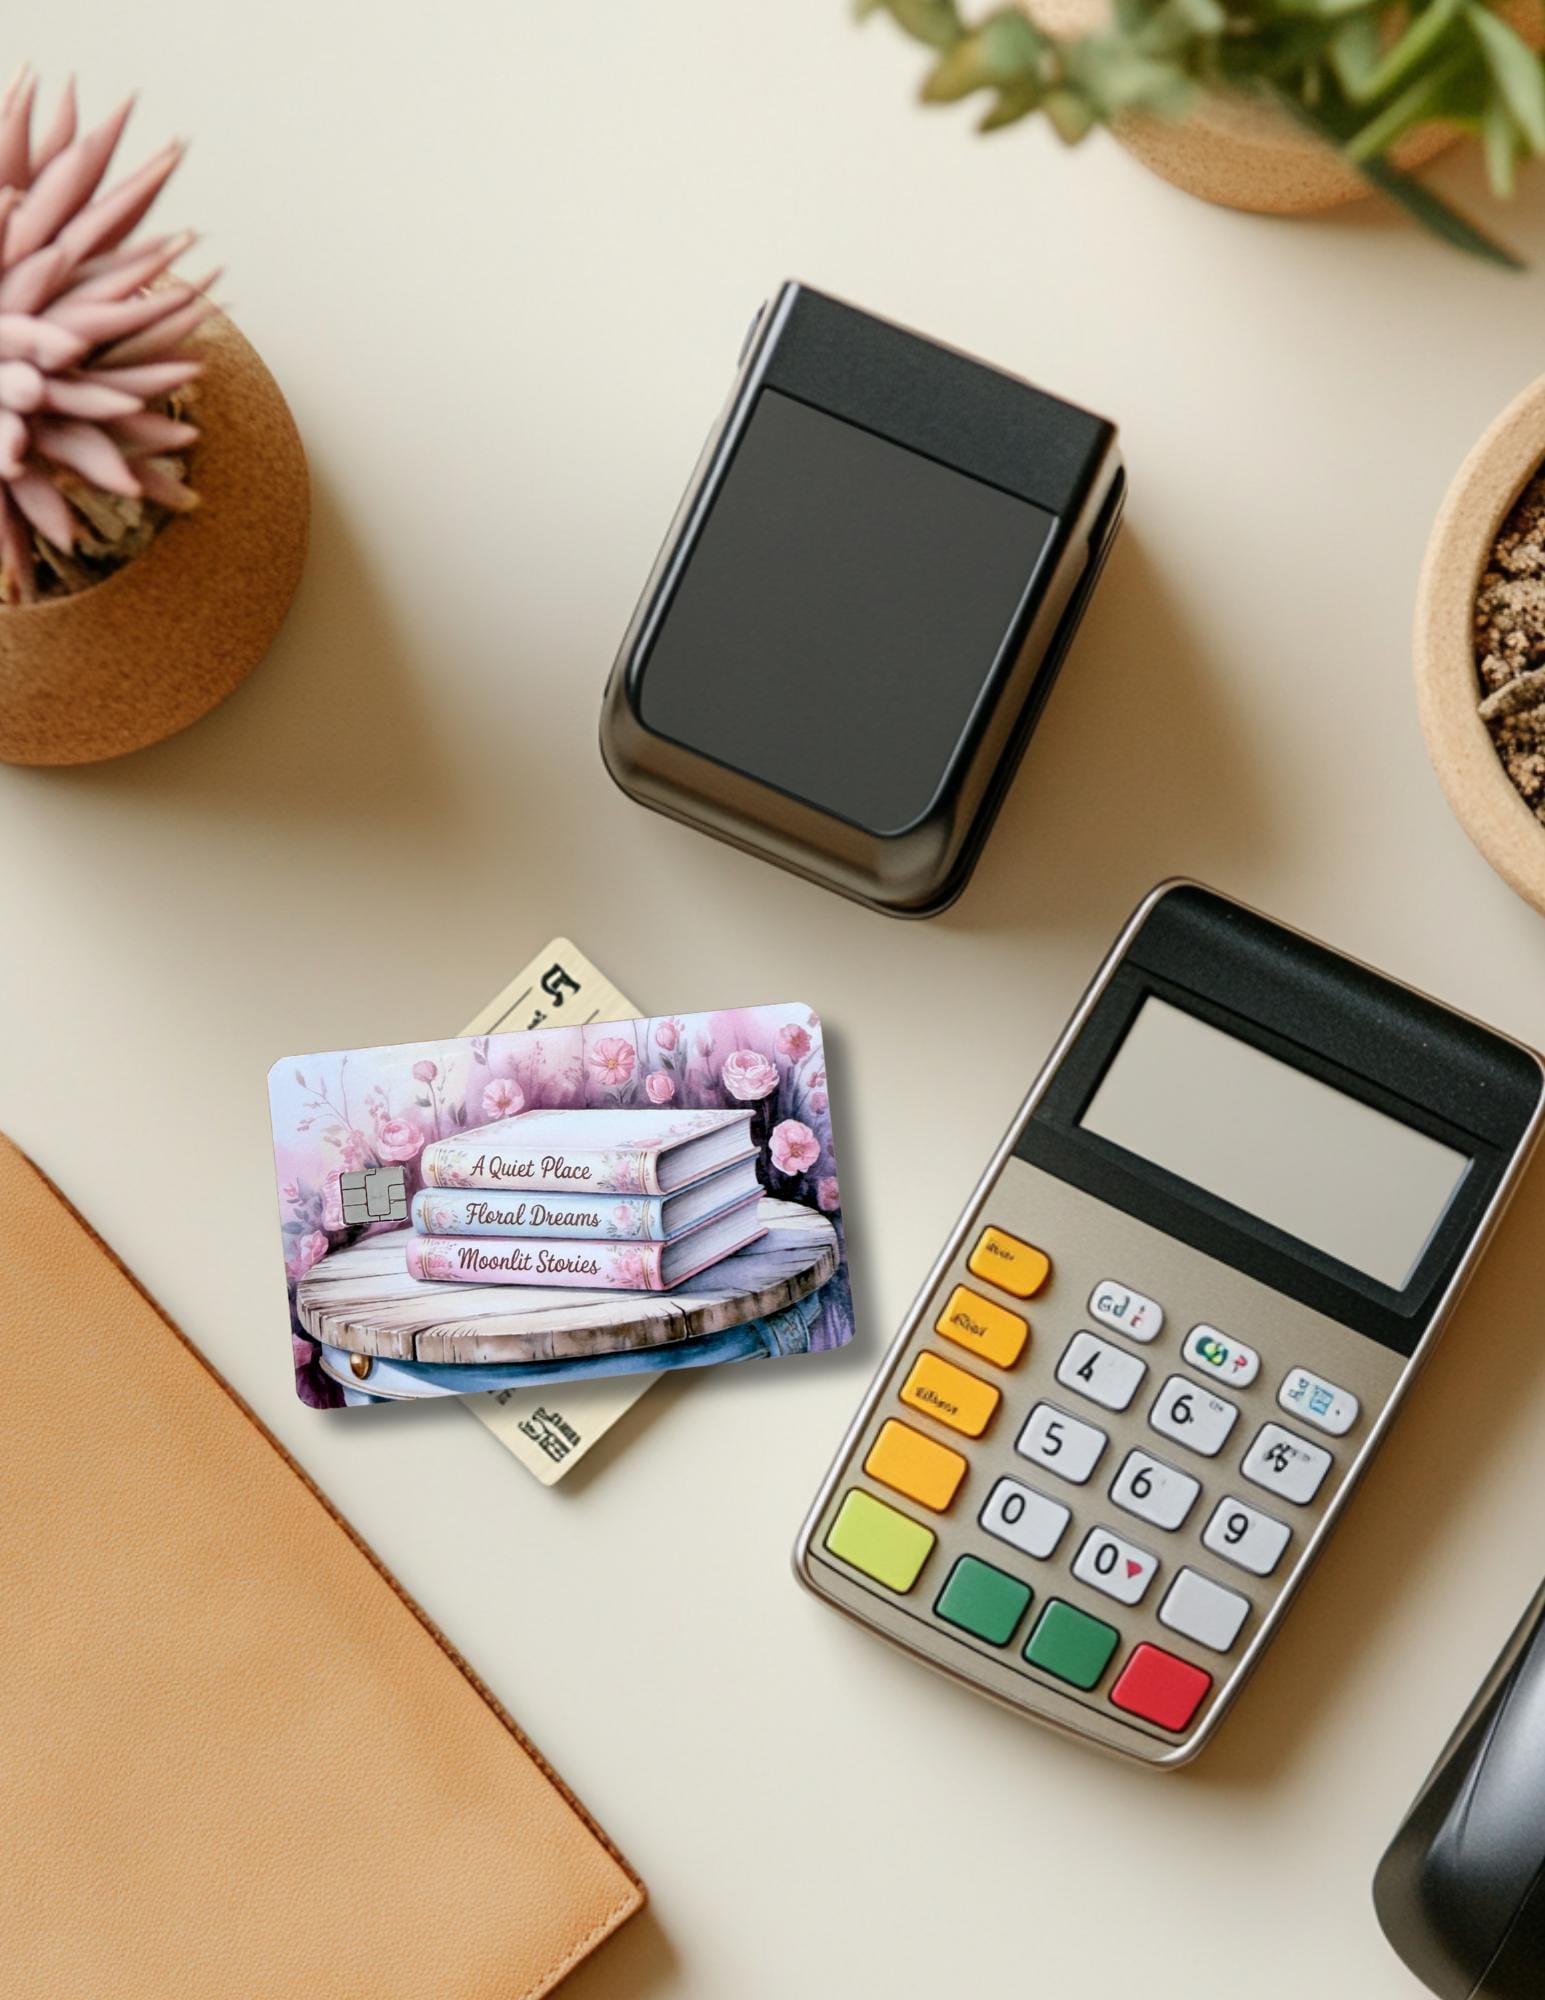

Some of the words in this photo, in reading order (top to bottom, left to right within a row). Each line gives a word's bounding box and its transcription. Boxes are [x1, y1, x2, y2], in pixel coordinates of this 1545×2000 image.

[471, 1155, 485, 1176] A
[489, 1156, 535, 1180] Quiet
[541, 1156, 592, 1180] Place
[465, 1203, 527, 1225] Floral
[530, 1204, 601, 1227] Dreams
[458, 1248, 533, 1271] Moonlit
[537, 1249, 600, 1274] Stories
[1040, 1422, 1064, 1456] 5
[1130, 1467, 1153, 1499] 6
[1001, 1493, 1026, 1525] 0
[1223, 1513, 1249, 1544] 9
[1094, 1543, 1118, 1574] 0
